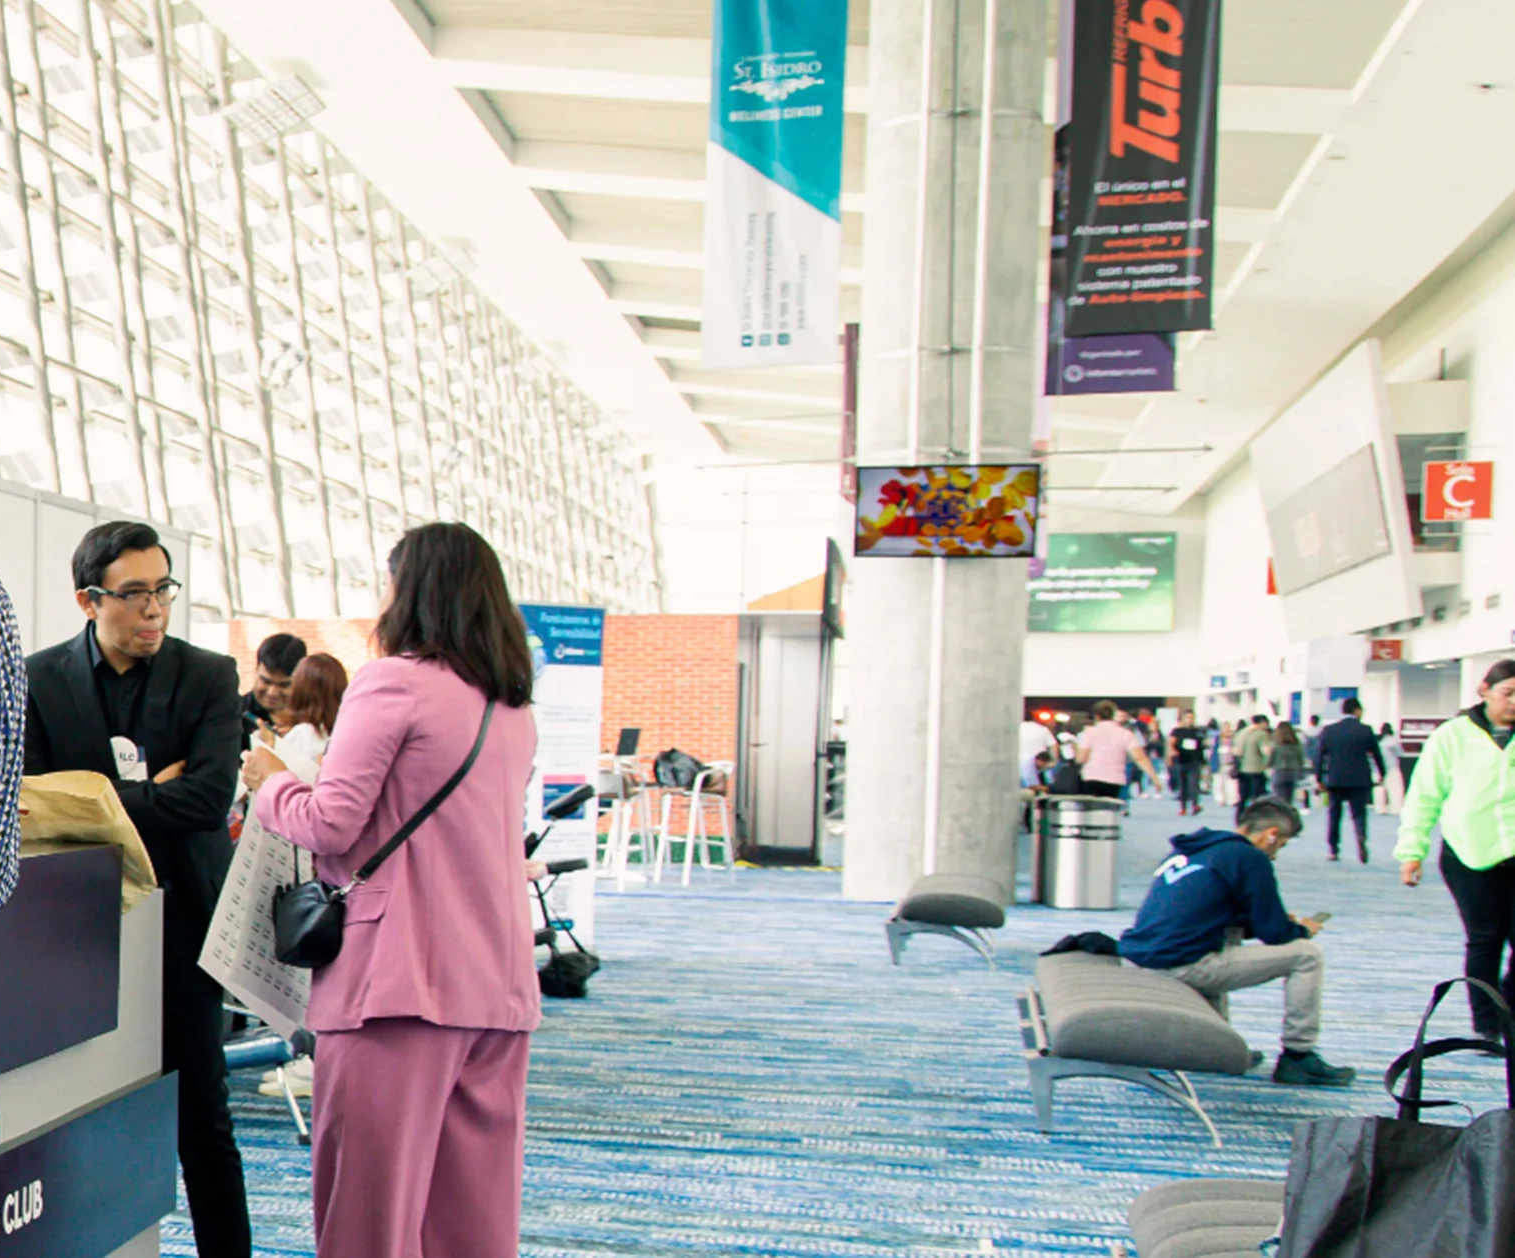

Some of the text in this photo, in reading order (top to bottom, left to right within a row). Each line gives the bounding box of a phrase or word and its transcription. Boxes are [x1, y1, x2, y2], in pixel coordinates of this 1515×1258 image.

[1110, 0, 1185, 163] Turb
[1442, 475, 1476, 508] C
[2, 1179, 43, 1235] CLUB
